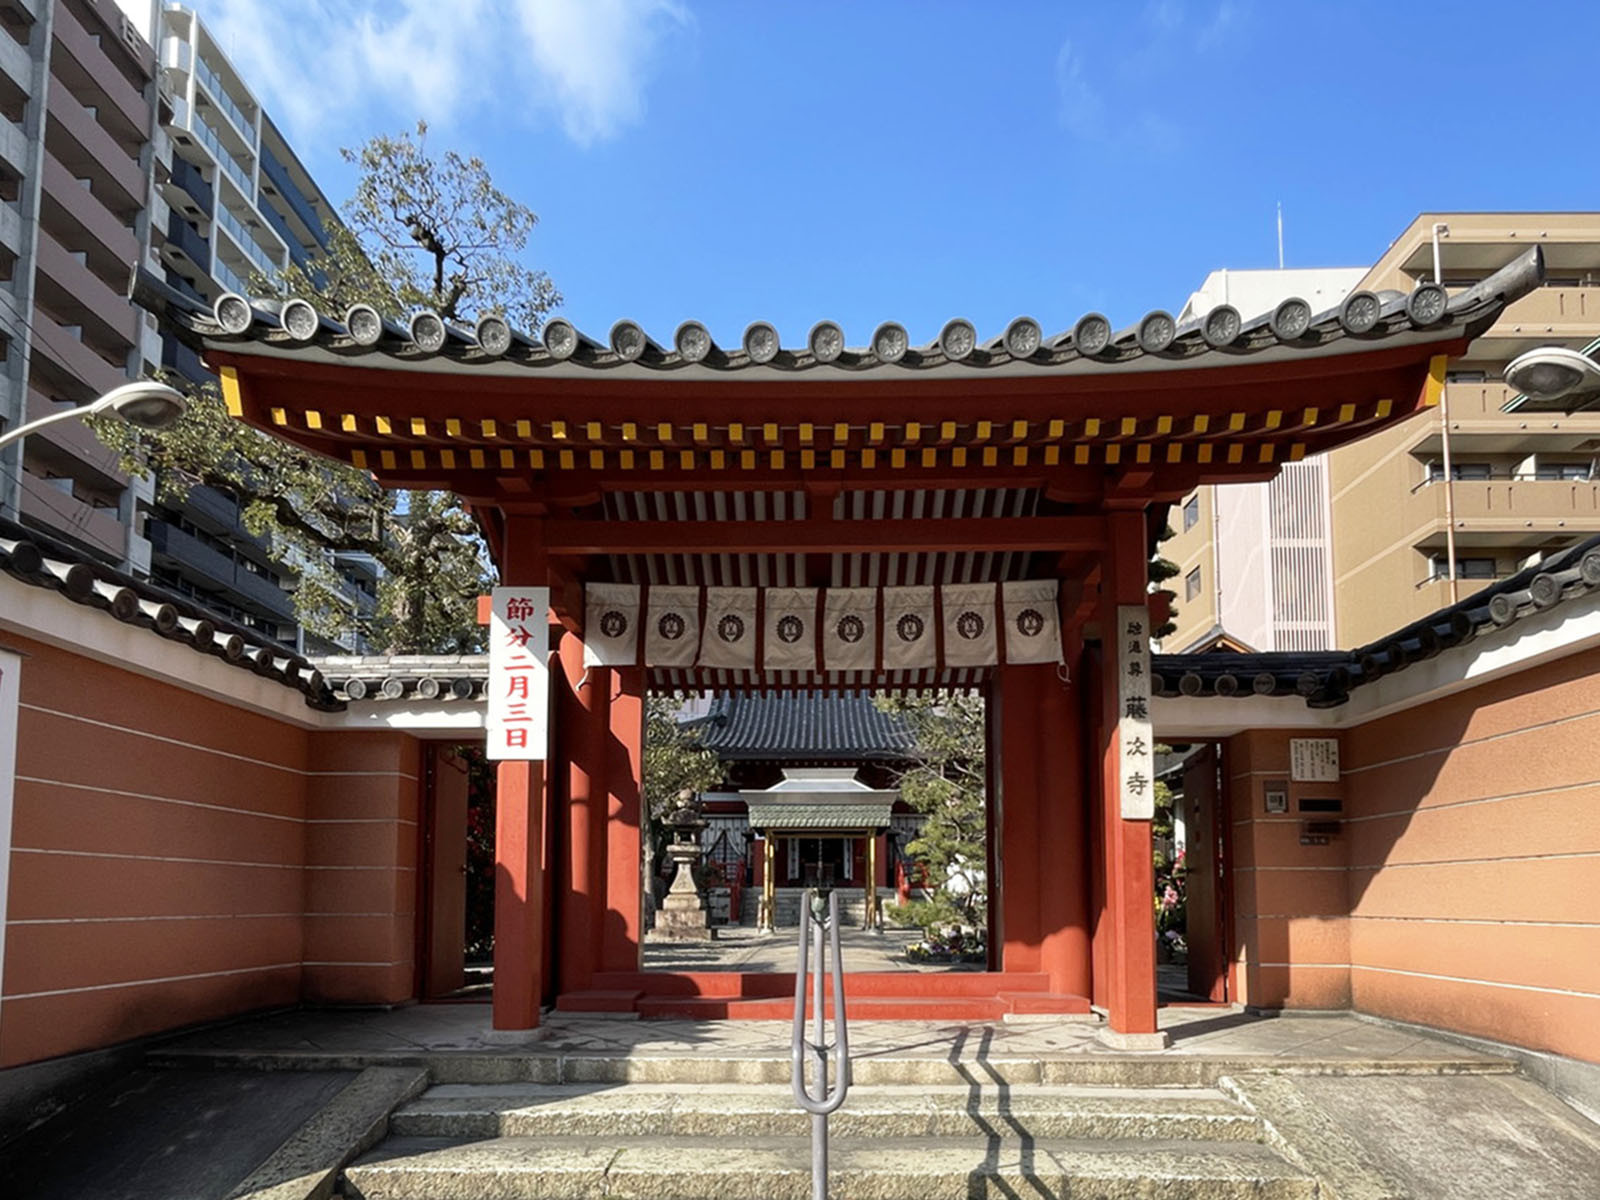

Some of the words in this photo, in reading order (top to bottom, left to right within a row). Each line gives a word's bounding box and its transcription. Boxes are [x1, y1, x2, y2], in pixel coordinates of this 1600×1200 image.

[502, 597, 535, 748] 節分二月三日
[1125, 696, 1149, 796] 藤次寺
